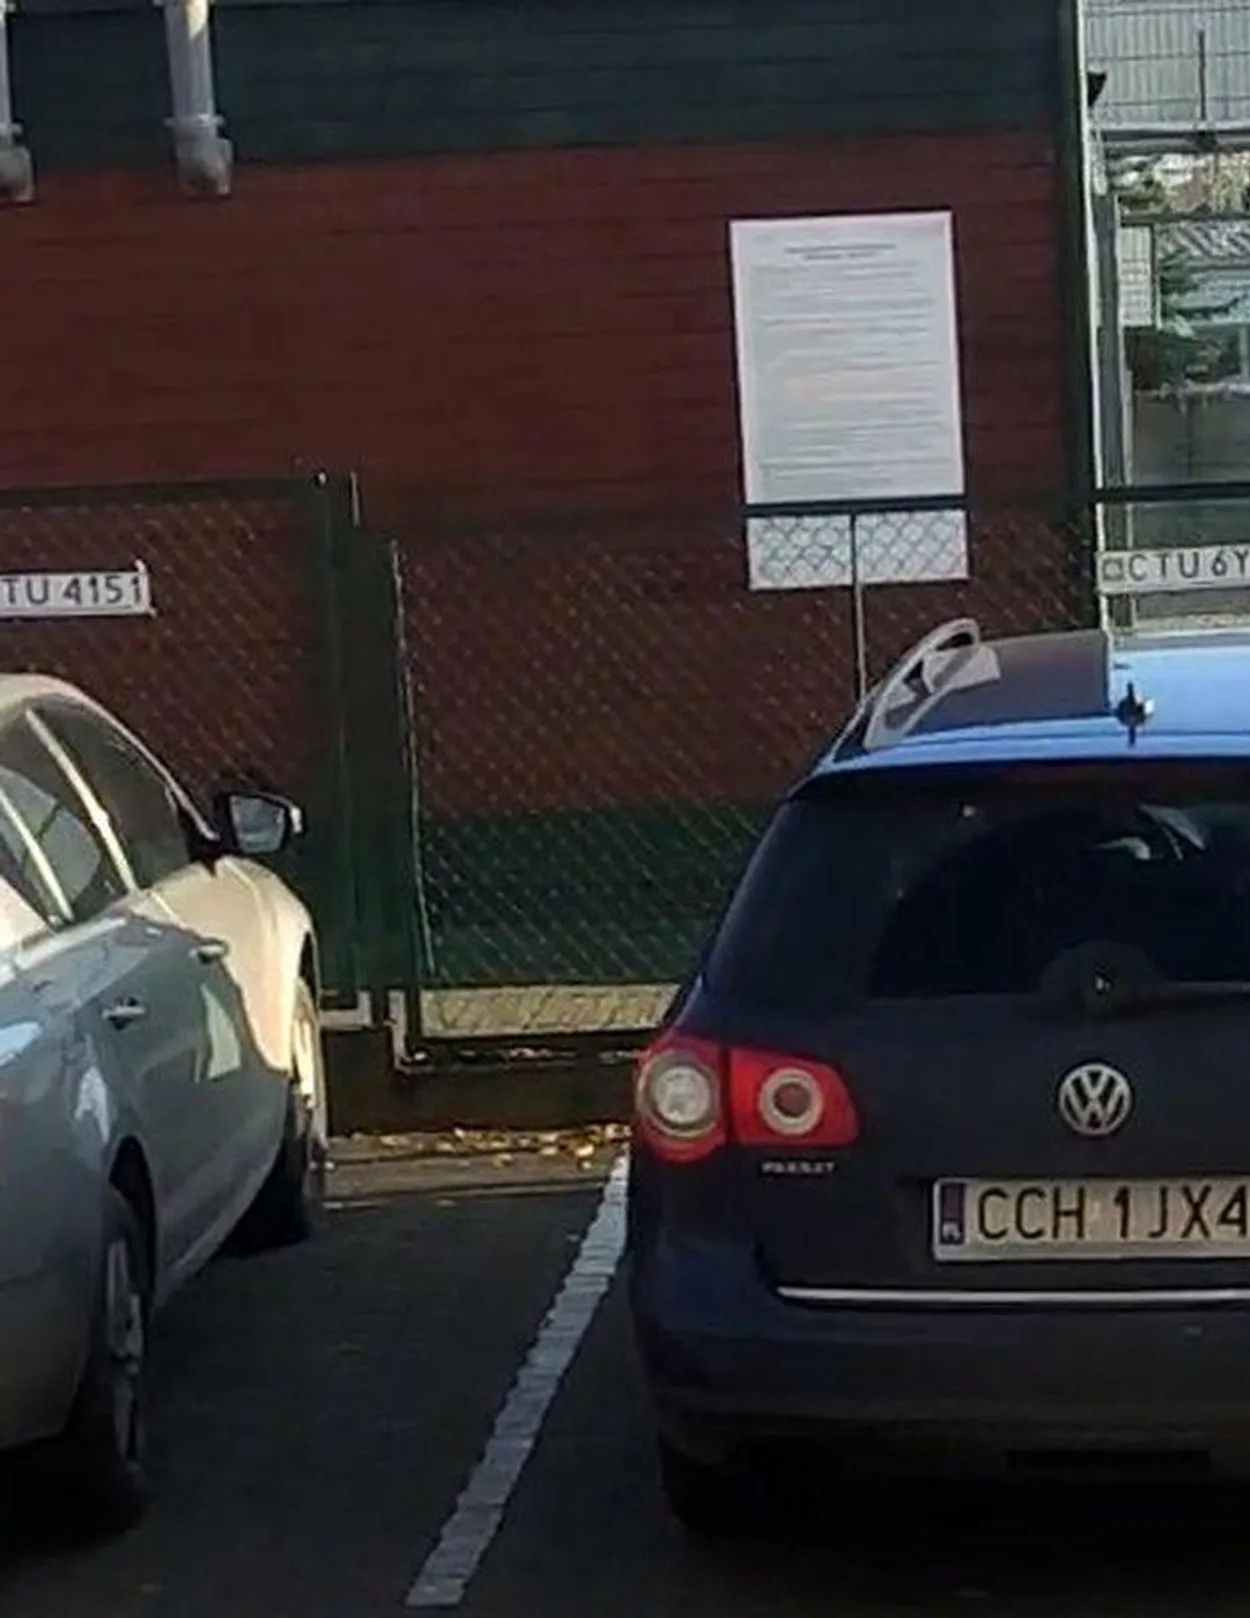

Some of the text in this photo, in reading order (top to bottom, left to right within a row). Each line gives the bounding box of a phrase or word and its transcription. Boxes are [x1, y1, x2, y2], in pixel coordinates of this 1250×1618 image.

[1128, 553, 1199, 581] CTU
[977, 1185, 1248, 1239] CCH 1JX4
